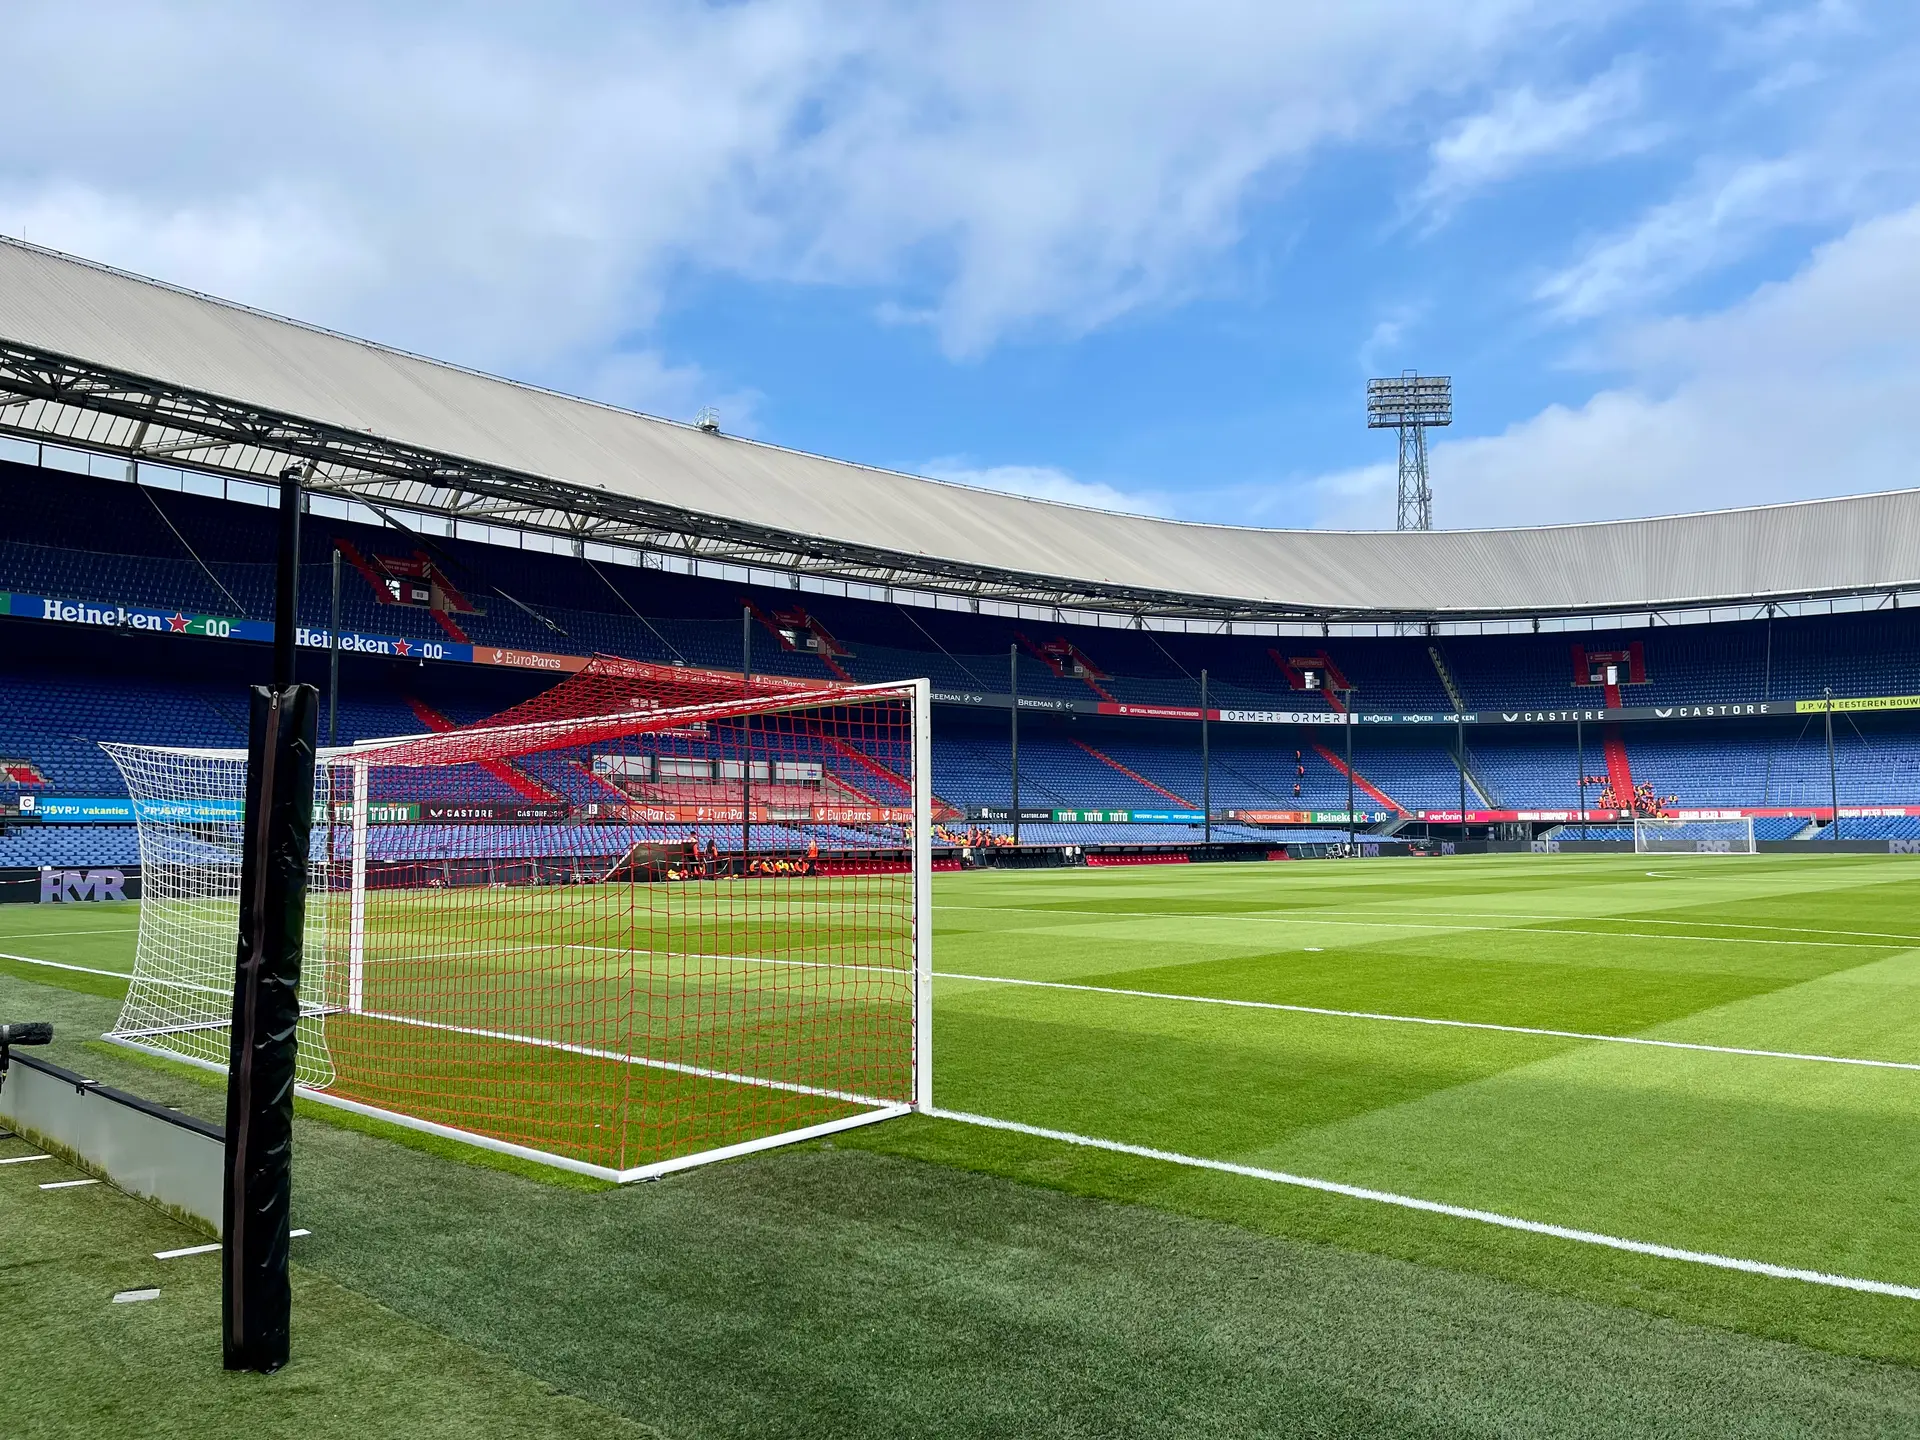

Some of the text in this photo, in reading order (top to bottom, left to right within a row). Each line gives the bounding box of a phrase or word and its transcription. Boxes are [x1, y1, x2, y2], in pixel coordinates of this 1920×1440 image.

[43, 599, 162, 631] Heineken
[505, 652, 561, 668] EuroParcs
[930, 692, 960, 702] REEMAN
[1018, 699, 1053, 708] BREEMAN
[1838, 700, 1887, 708] EESTEREN
[1680, 704, 1768, 717] CASTORE
[1228, 711, 1273, 721] ORMER
[1291, 713, 1340, 723] ORMER
[1524, 711, 1604, 721] CASTORE
[23, 798, 31, 808] C
[28, 806, 129, 815] RIJSVRIJ vakanties
[370, 807, 409, 820] TOTO
[447, 809, 493, 818] CASTORE
[708, 807, 757, 821] EuroPacs
[827, 809, 871, 821] EuroParcs
[1058, 812, 1078, 822] TOTO
[1084, 812, 1104, 822] TOTO
[1109, 812, 1129, 822] TOTO
[1430, 811, 1475, 821] verlonin.nl
